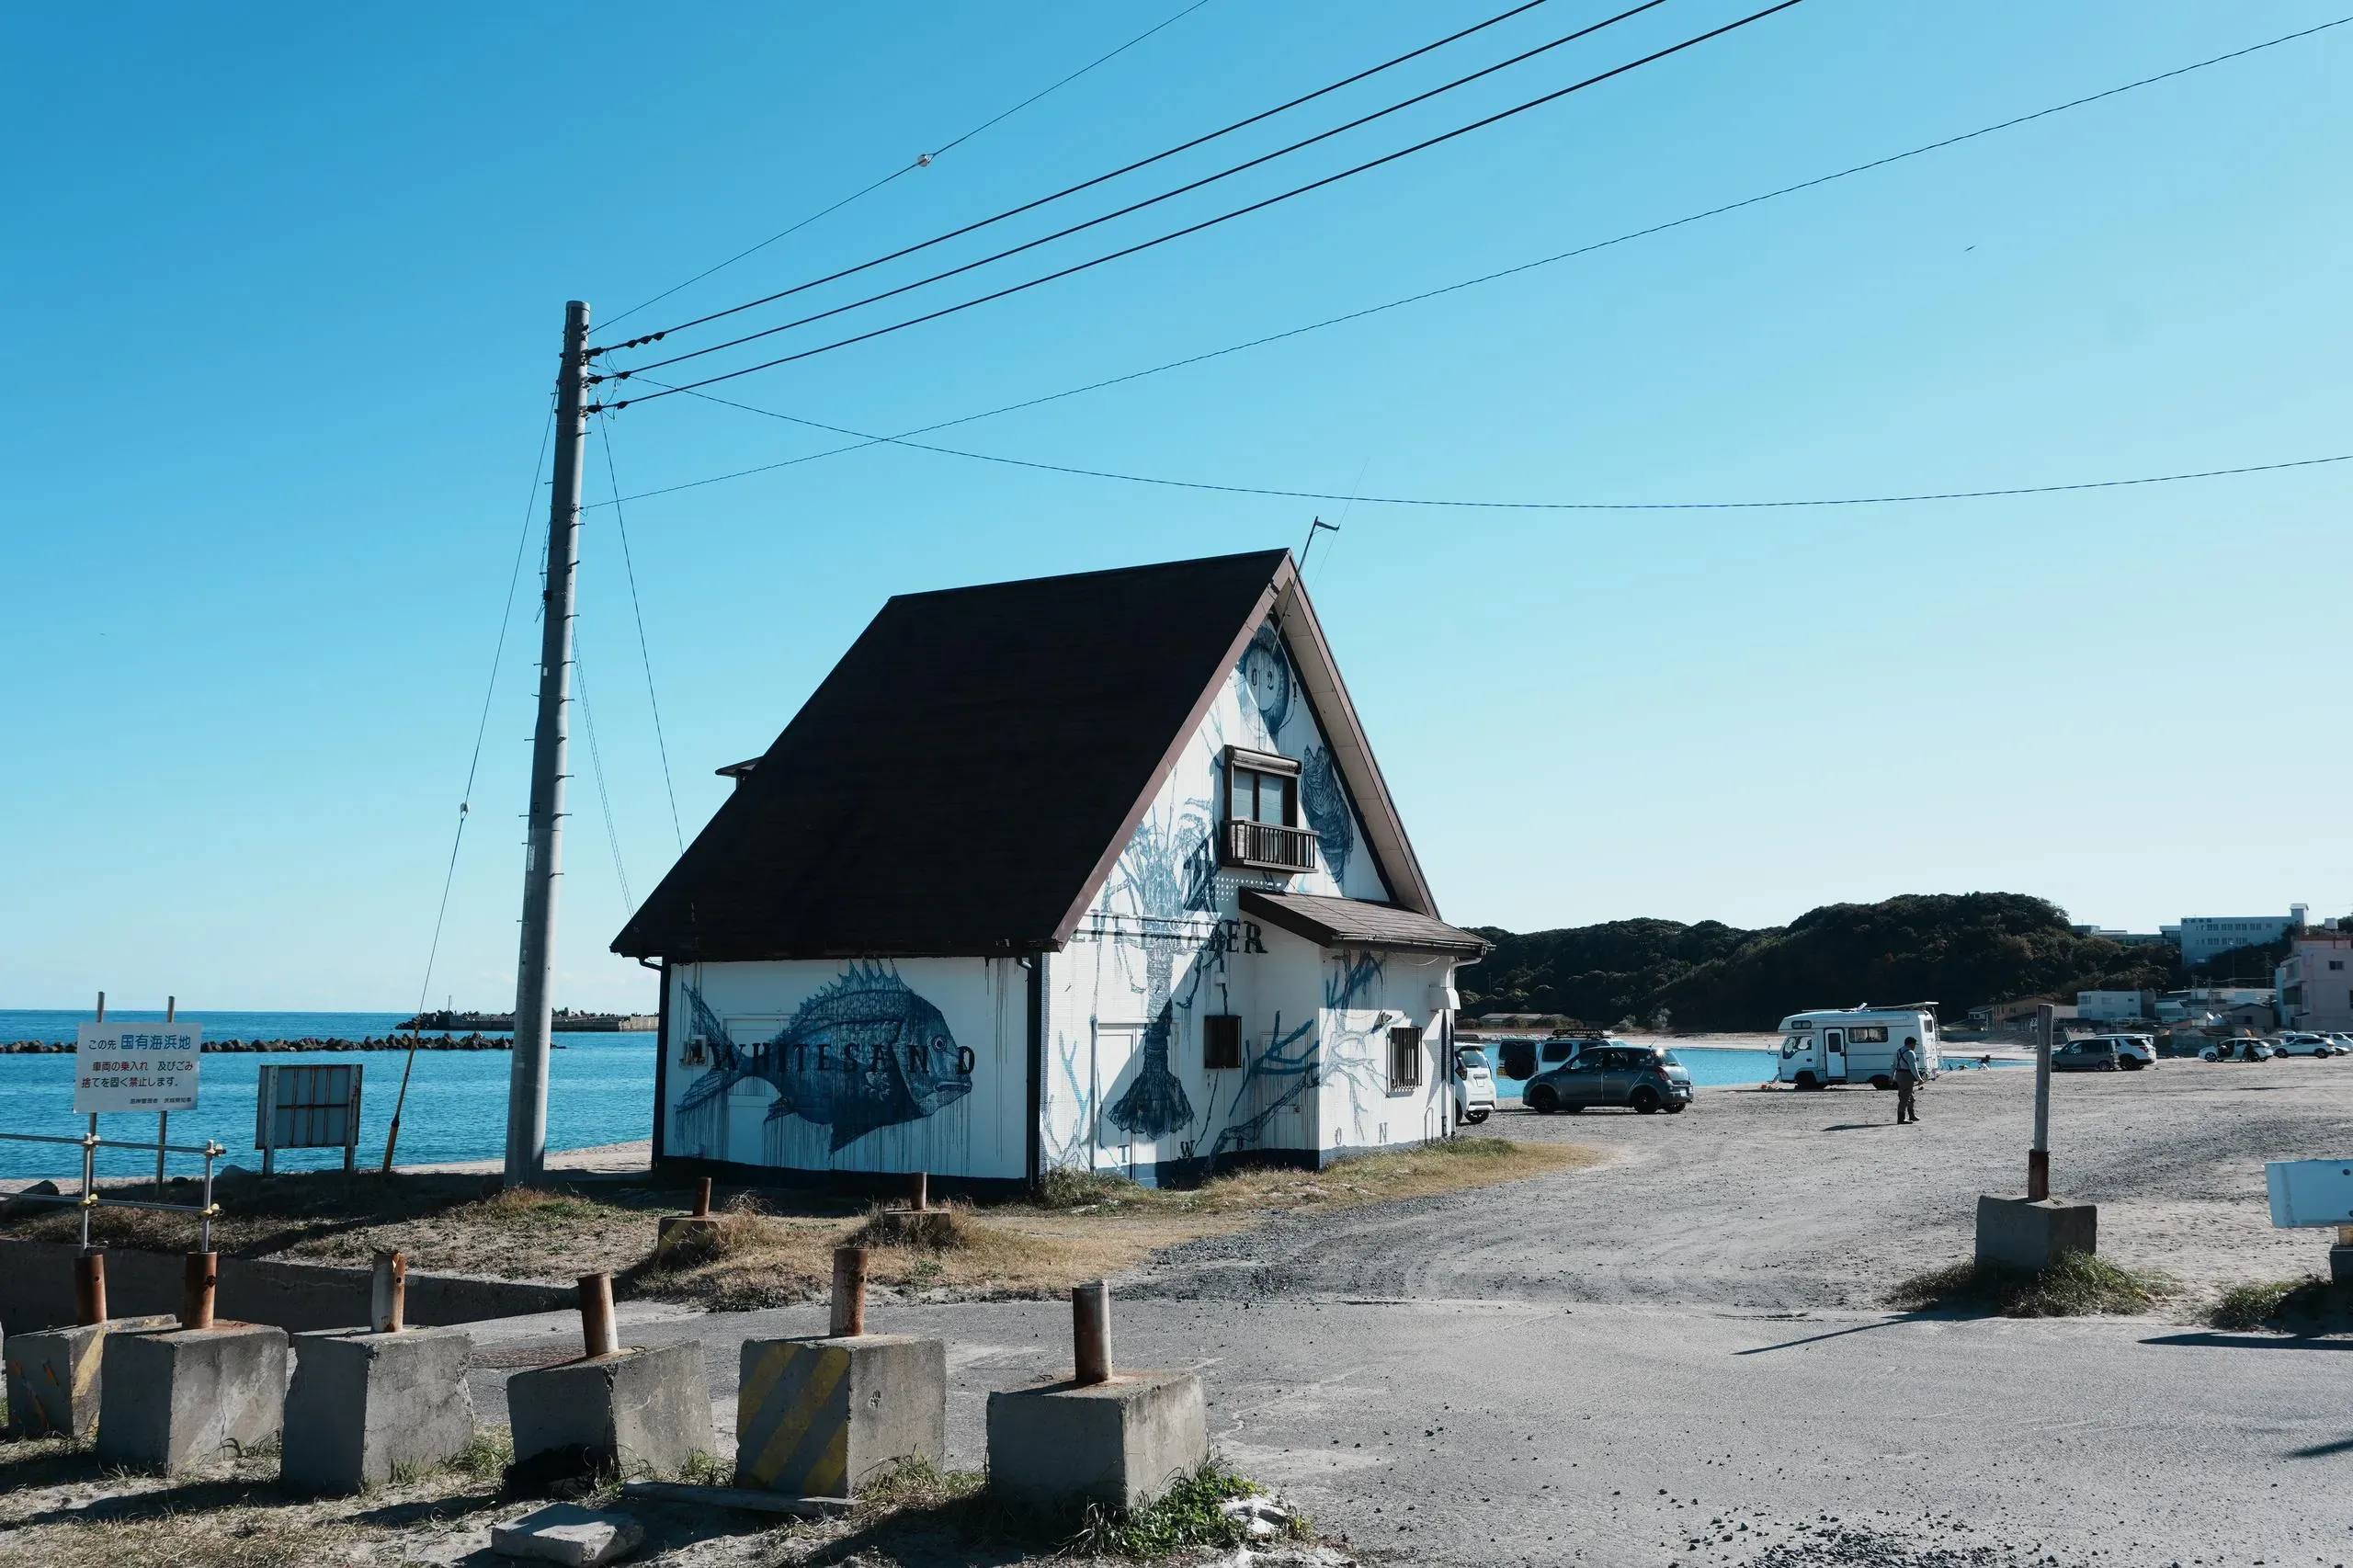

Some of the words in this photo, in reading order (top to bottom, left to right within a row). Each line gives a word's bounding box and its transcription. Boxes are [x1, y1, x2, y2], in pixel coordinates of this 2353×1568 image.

[88, 1039, 117, 1050] この先
[120, 1034, 191, 1050] 国有海浜地
[93, 1061, 148, 1072] 車両の乗入れ
[157, 1061, 193, 1071] 及びごみ
[81, 1077, 178, 1088] 捨てを固く禁止します。
